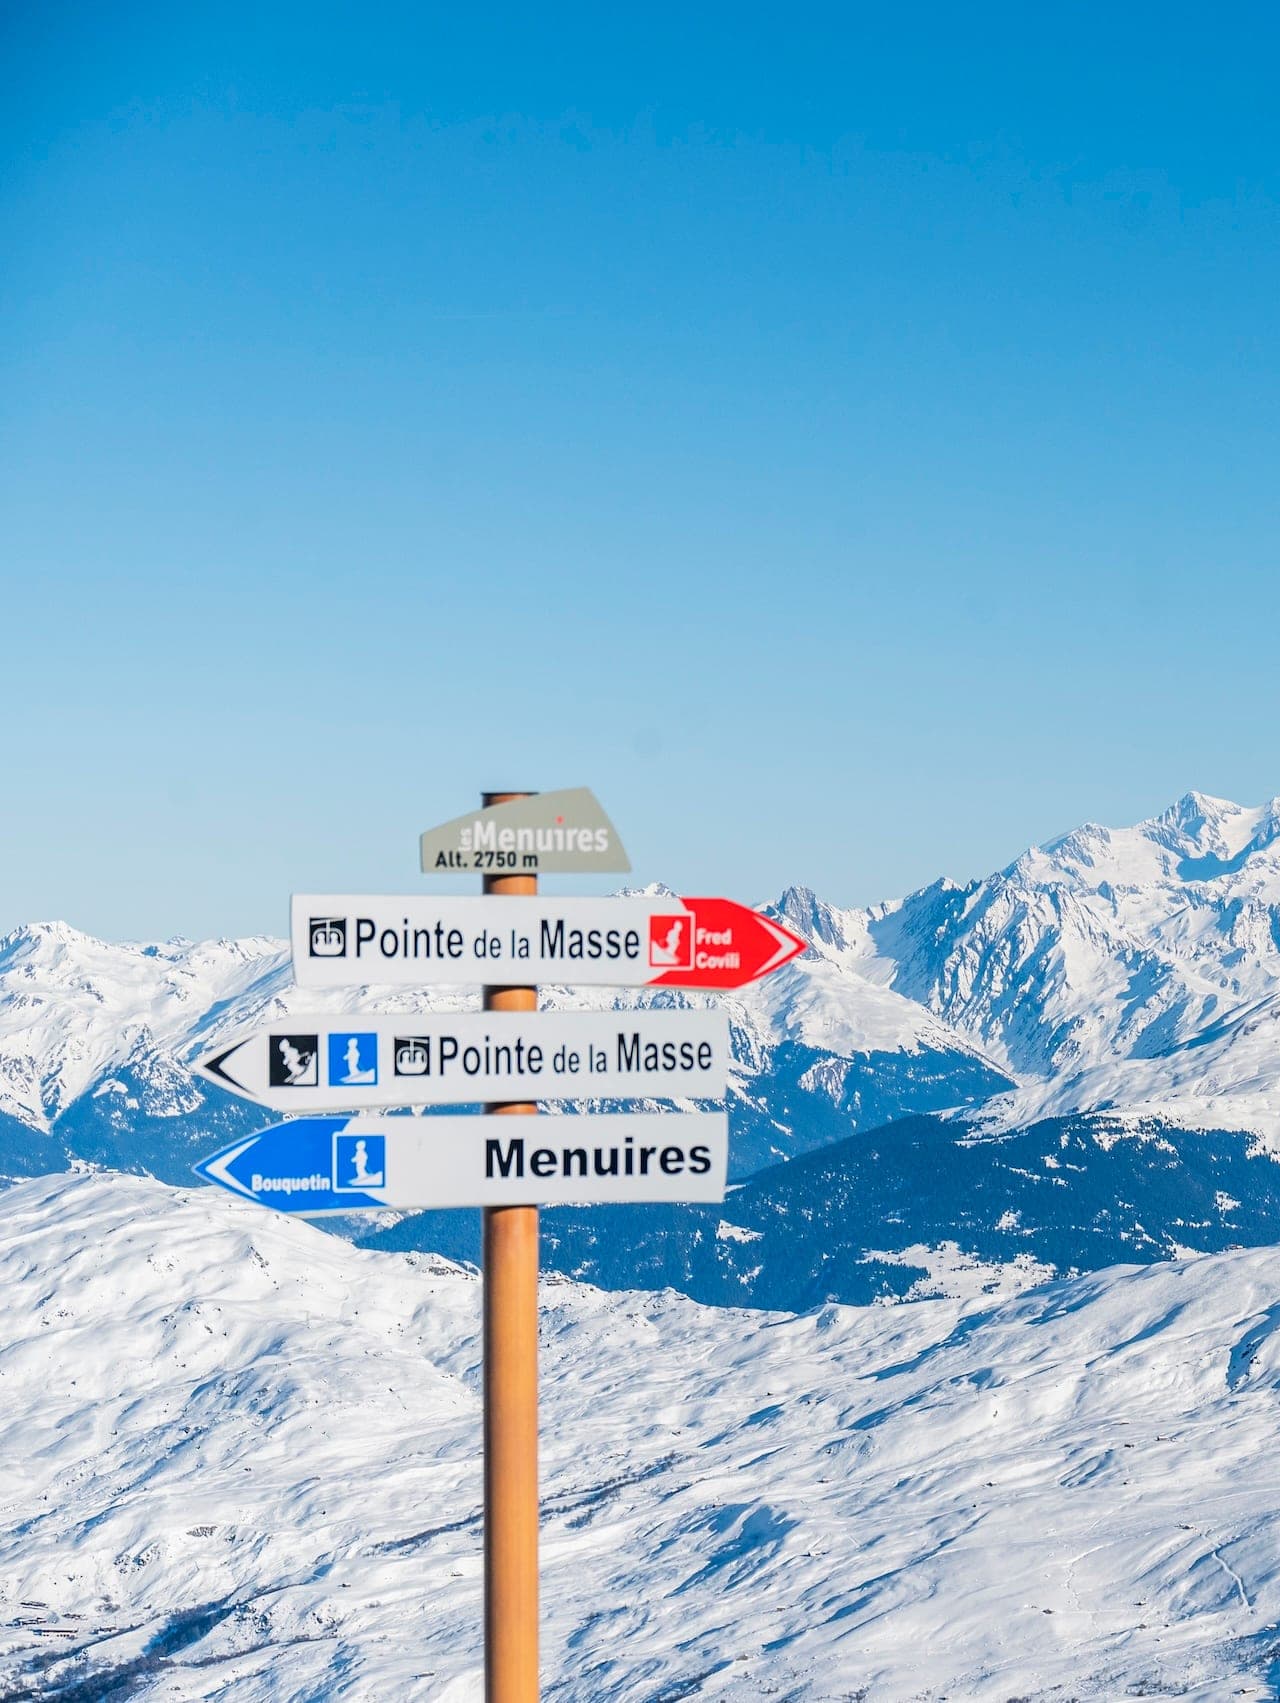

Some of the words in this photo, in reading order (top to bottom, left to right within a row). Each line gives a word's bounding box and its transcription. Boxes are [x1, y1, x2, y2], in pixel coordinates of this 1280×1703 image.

[473, 816, 609, 852] Menuires
[434, 851, 468, 868] Alt.
[474, 851, 517, 868] 2750
[523, 854, 539, 867] m
[355, 917, 464, 959] Pointe
[473, 929, 502, 958] de
[511, 928, 531, 959] la
[541, 919, 640, 959] Masse
[696, 927, 732, 945] Fred
[439, 1035, 543, 1076] Pointe
[552, 1046, 580, 1074] de
[588, 1043, 607, 1073] la
[617, 1033, 712, 1072] Masse
[485, 1137, 711, 1178] Menuires
[251, 1173, 331, 1195] Bouquetin
